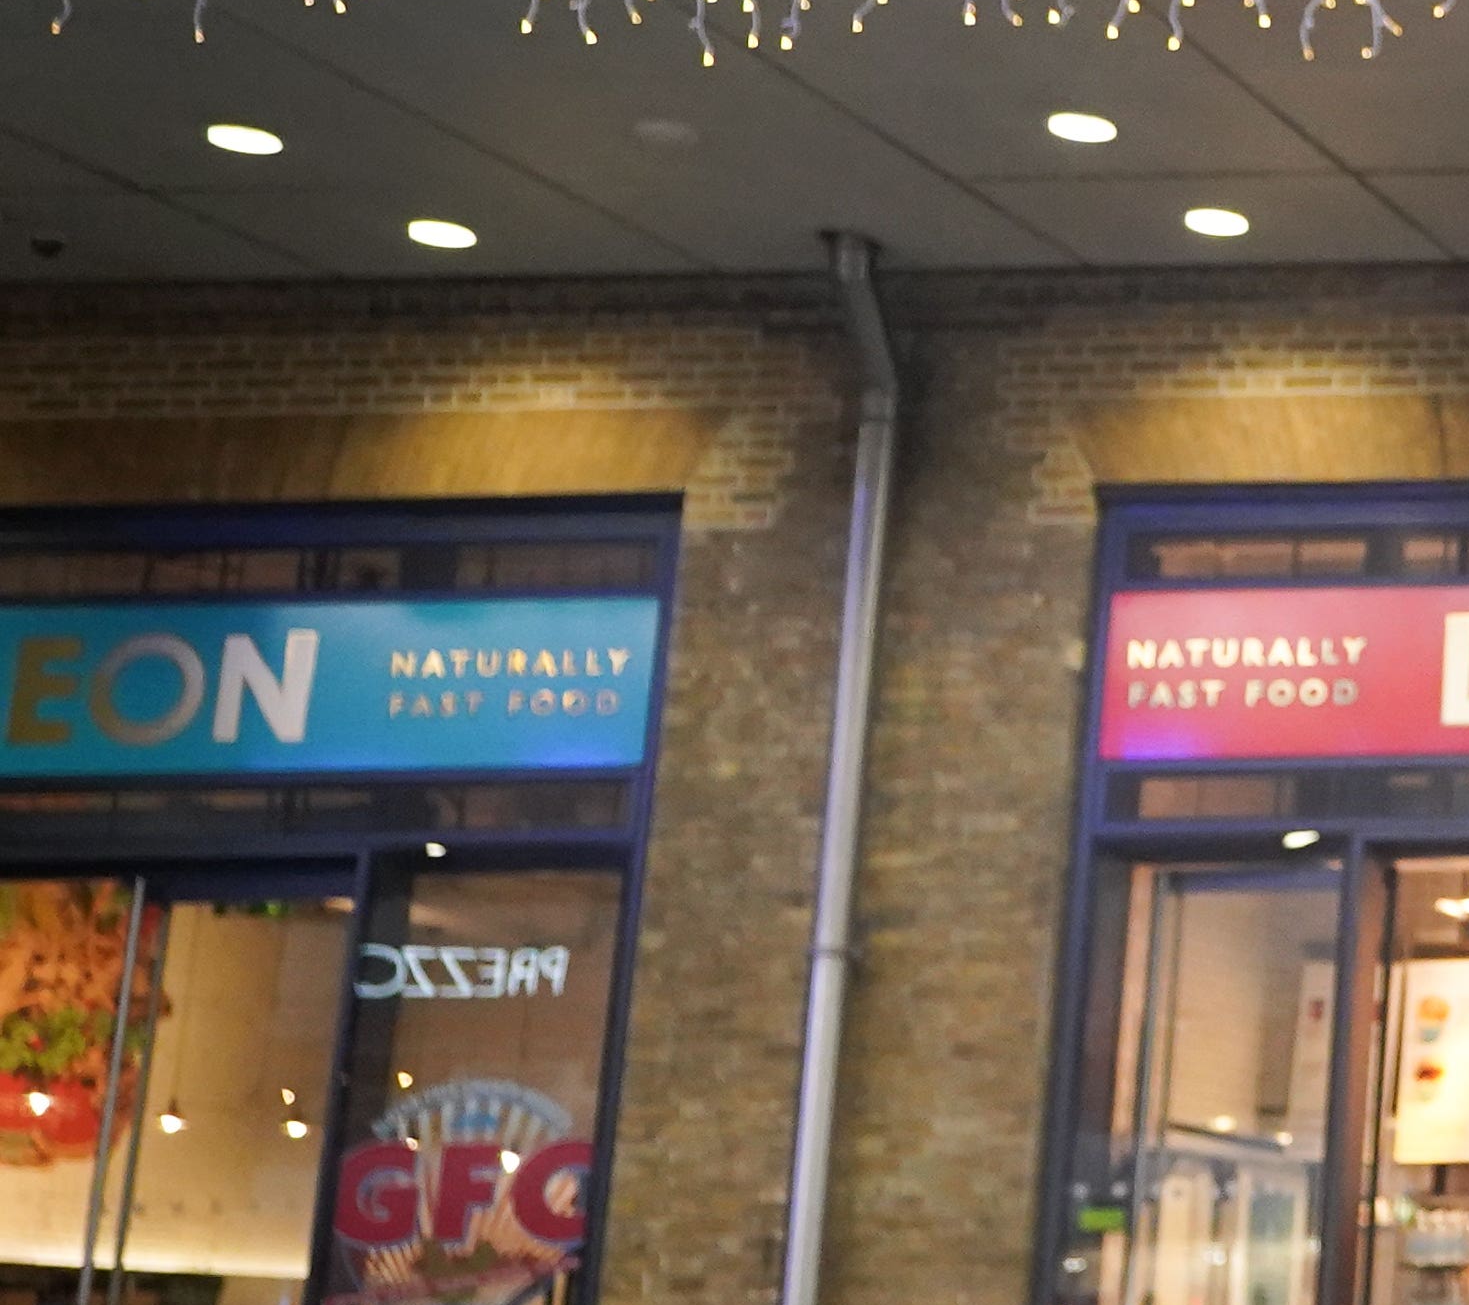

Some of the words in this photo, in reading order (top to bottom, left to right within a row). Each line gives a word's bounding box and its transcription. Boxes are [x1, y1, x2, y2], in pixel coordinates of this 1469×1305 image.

[389, 646, 631, 679] NATURALLY
[1127, 635, 1368, 669] NATURALLY
[388, 690, 485, 719] FAST
[507, 688, 621, 718] FOOD
[1127, 680, 1226, 708] FAST
[1244, 678, 1361, 708] FOOD
[333, 1140, 594, 1248] GFC
